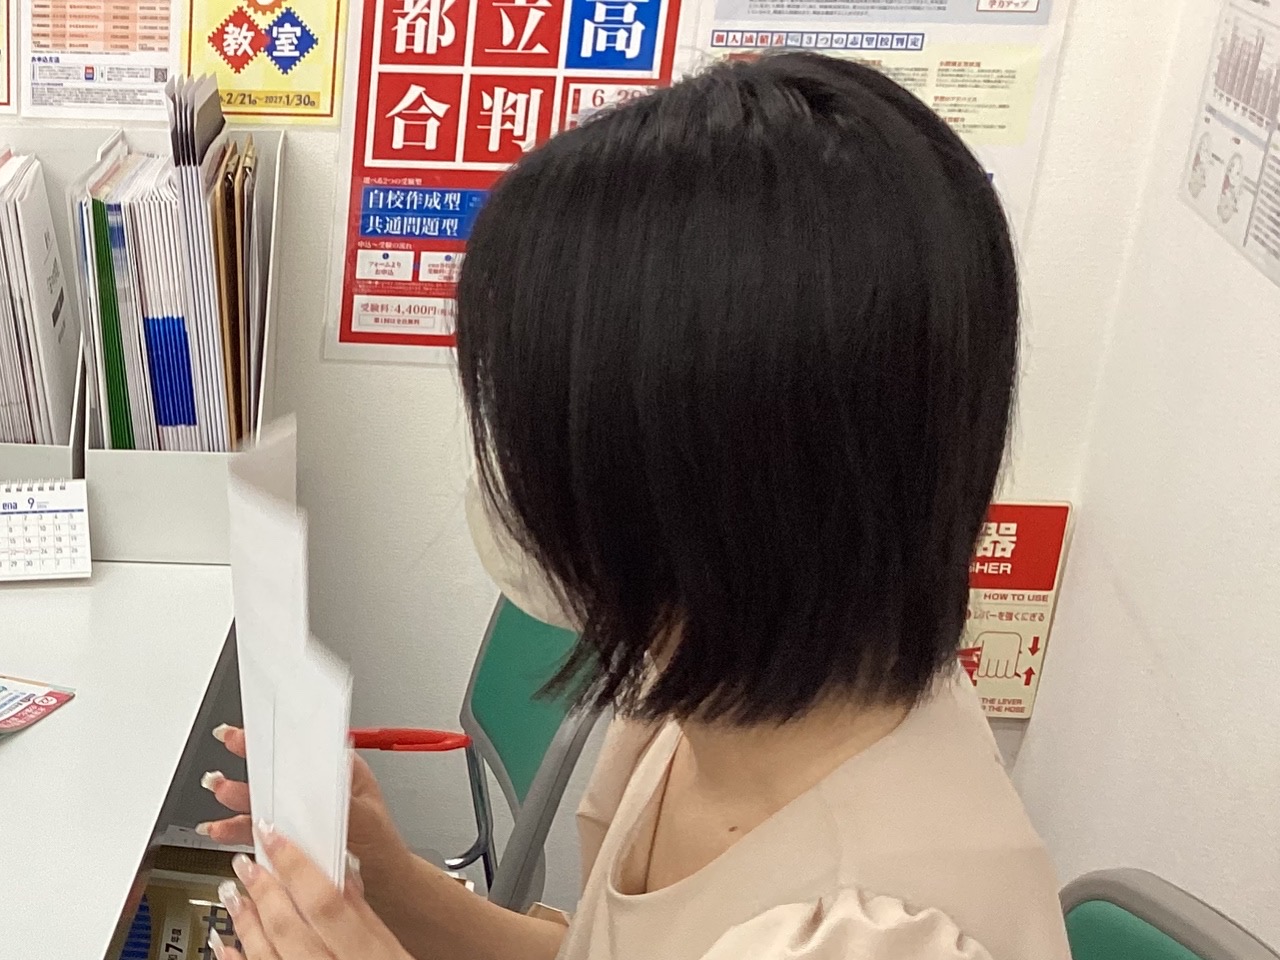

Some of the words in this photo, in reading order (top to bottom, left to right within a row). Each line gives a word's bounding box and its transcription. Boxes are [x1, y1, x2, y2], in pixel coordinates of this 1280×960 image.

[223, 22, 302, 57] 教室
[385, 84, 544, 152] 合判
[369, 189, 461, 211] 自校作成型
[366, 215, 459, 237] 共通問題型
[2, 502, 18, 510] ena
[27, 497, 35, 509] 9
[976, 522, 1017, 558] 器
[983, 593, 1008, 601] HOW
[1011, 593, 1024, 601] TO
[1027, 594, 1048, 602] USE
